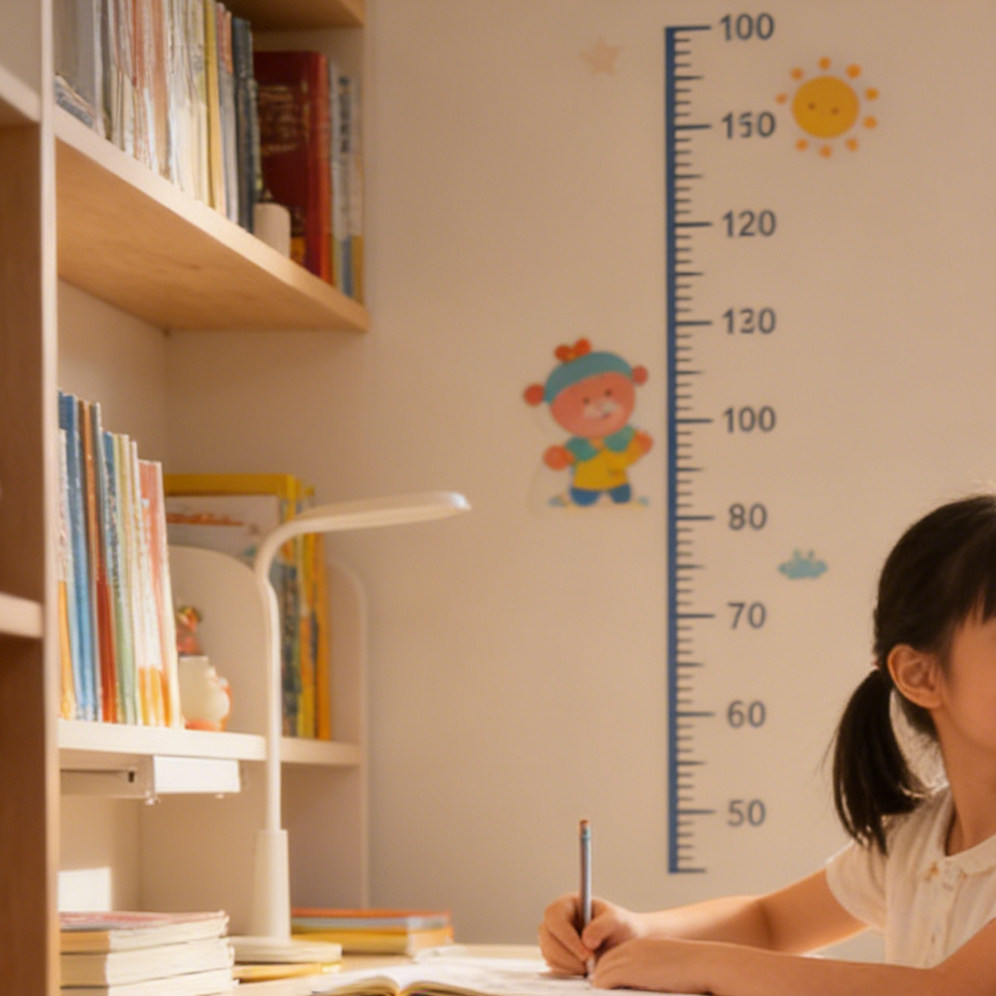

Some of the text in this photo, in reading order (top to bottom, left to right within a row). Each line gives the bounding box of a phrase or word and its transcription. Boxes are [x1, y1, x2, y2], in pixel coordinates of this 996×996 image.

[720, 12, 775, 41] 100
[722, 210, 777, 238] 120
[723, 405, 777, 433] 100
[728, 503, 768, 531] 80
[727, 601, 767, 629] 70
[726, 700, 767, 728] 60
[727, 798, 767, 827] 50
